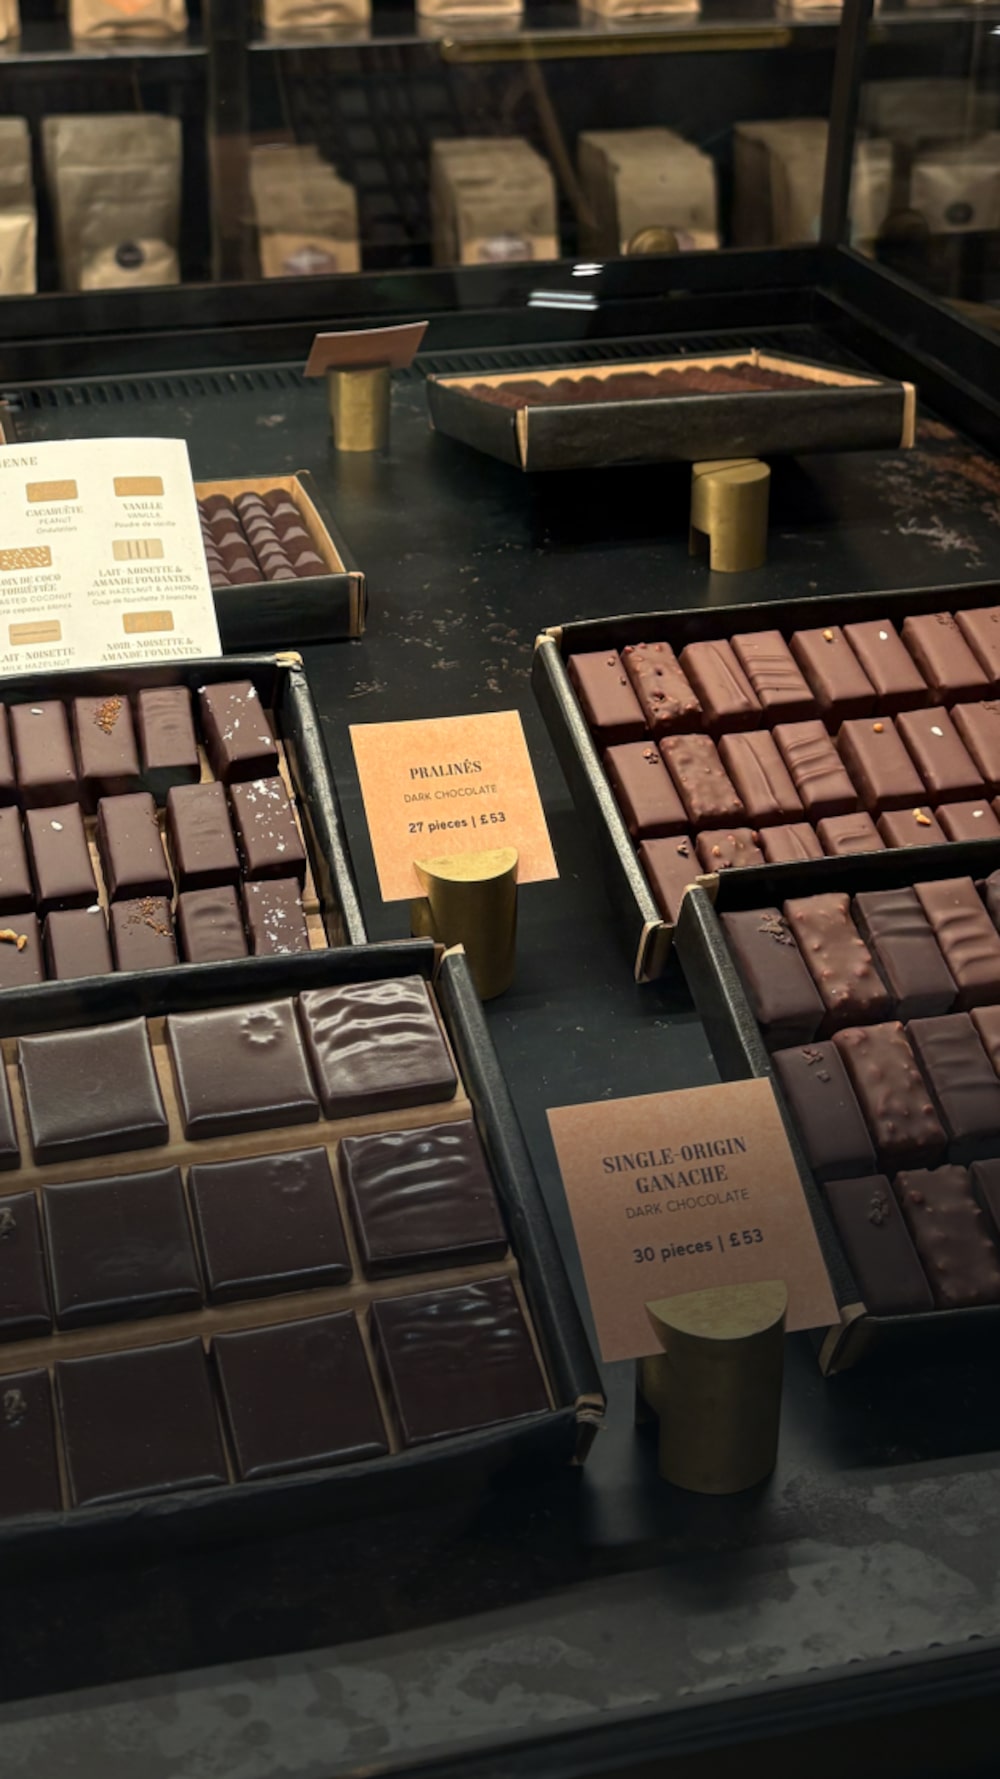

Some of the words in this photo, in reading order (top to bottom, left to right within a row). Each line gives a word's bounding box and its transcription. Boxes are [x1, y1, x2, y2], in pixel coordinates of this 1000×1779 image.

[122, 502, 164, 511] VANILLE
[39, 516, 72, 525] PEANUT
[98, 568, 121, 577] LAIT
[127, 566, 174, 575] NOISETTE
[20, 575, 33, 584] DE
[35, 573, 61, 582] COCO
[92, 577, 134, 587] AMANDE
[135, 575, 192, 585] FONDANTES
[87, 589, 106, 597] MILK
[109, 585, 153, 595] HAZELNUT
[164, 584, 199, 592] ALMOND
[30, 592, 72, 603] COCONUT
[106, 641, 131, 651] NOIR
[136, 638, 185, 648] NOISETTE
[186, 637, 194, 645] &
[26, 647, 75, 660] NOISETTE
[100, 650, 143, 662] AMANDE
[144, 647, 202, 658] FONDANTES
[25, 658, 71, 670] HAZELNUT
[409, 758, 483, 780] PRALINÉS
[403, 792, 432, 803] DARK
[434, 784, 498, 800] CHOCOLATE
[408, 821, 424, 834] 27
[428, 819, 468, 834] pieces
[480, 811, 506, 826] £53
[602, 1136, 747, 1174] SINGLE-ORIGIN
[635, 1164, 729, 1195] GANACHE
[625, 1203, 663, 1220] DARK
[666, 1187, 750, 1213] CHOCOLATE
[632, 1246, 655, 1264] 30
[661, 1240, 713, 1263] pieces
[729, 1228, 764, 1248] £53
